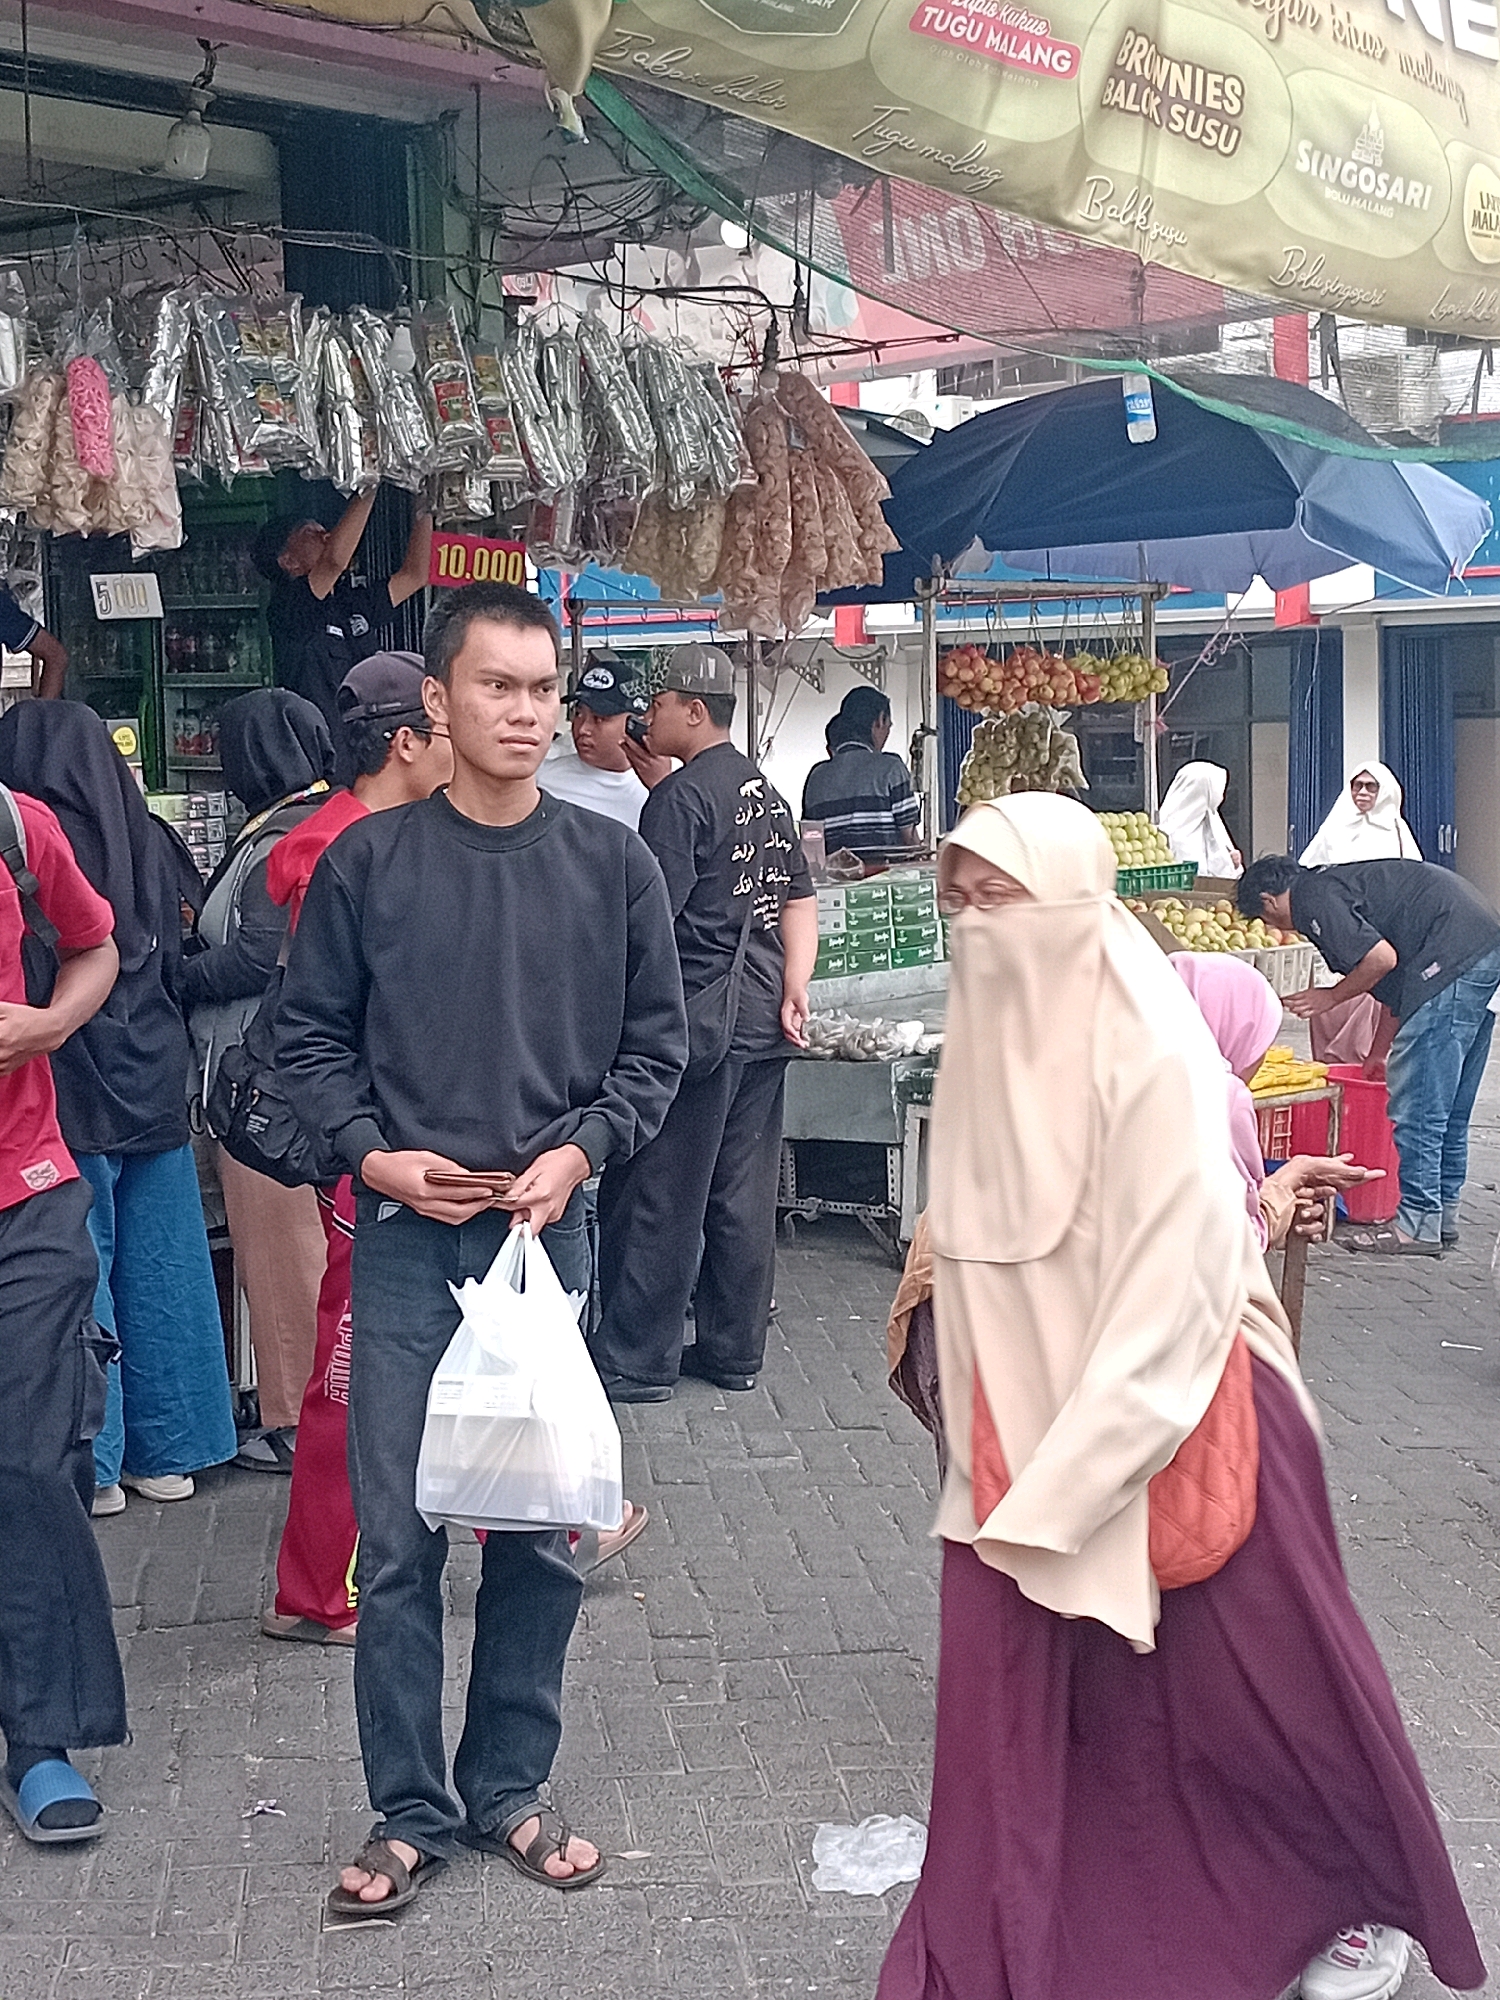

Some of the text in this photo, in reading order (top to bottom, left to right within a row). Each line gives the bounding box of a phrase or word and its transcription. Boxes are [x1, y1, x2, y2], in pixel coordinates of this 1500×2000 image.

[921, 5, 1073, 73] TUGU MALANG
[997, 3, 1049, 36] Kukus
[1115, 29, 1242, 115] BROWNIES
[1101, 77, 1239, 154] BALOK SUSU
[852, 104, 1005, 194] Tugu malang
[1295, 139, 1432, 211] SINGOSARI
[1324, 186, 1395, 218] BOLU MALANG
[1149, 221, 1188, 246] susu
[1268, 245, 1325, 290] Bolu
[437, 543, 523, 586] 10.000
[95, 577, 150, 615] 5000
